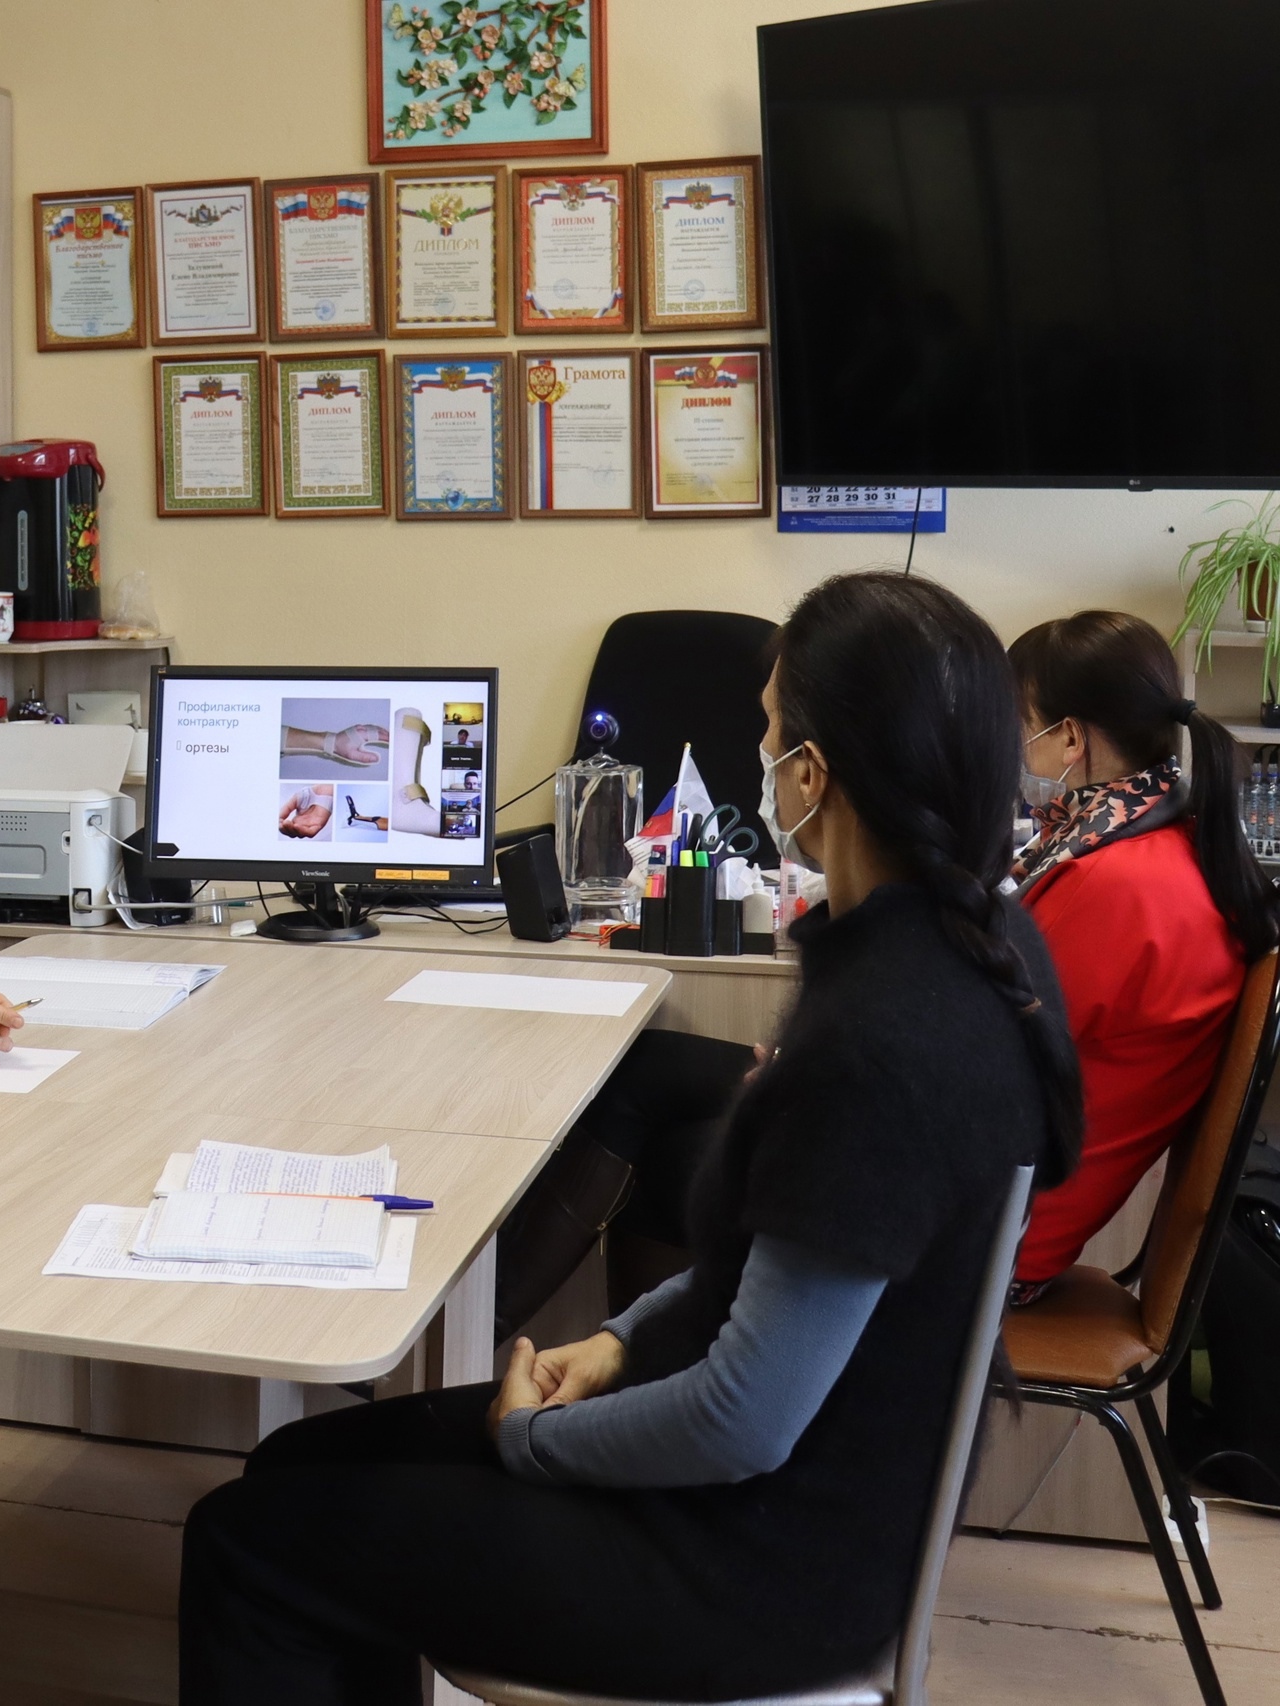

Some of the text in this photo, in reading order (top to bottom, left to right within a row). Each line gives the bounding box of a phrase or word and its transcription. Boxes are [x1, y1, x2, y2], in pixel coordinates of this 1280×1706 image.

[551, 216, 595, 226] ДИПЛОМ
[675, 216, 725, 227] ДИПЛОМ
[413, 238, 479, 253] ДИПЛОМ
[563, 366, 626, 383] Грамота
[681, 396, 732, 410] ДИПЛОМ
[190, 410, 233, 419] ДИПЛОМ
[308, 407, 352, 416] ДИПЛОМ
[431, 411, 477, 420] ДИПЛОМ
[807, 495, 820, 503] 27
[826, 494, 840, 502] 28
[845, 494, 859, 502] 29
[864, 493, 878, 501] 30
[885, 492, 896, 500] 31
[178, 701, 261, 713] Профилактика
[177, 718, 240, 729] контрактур
[185, 744, 230, 755] ортезы
